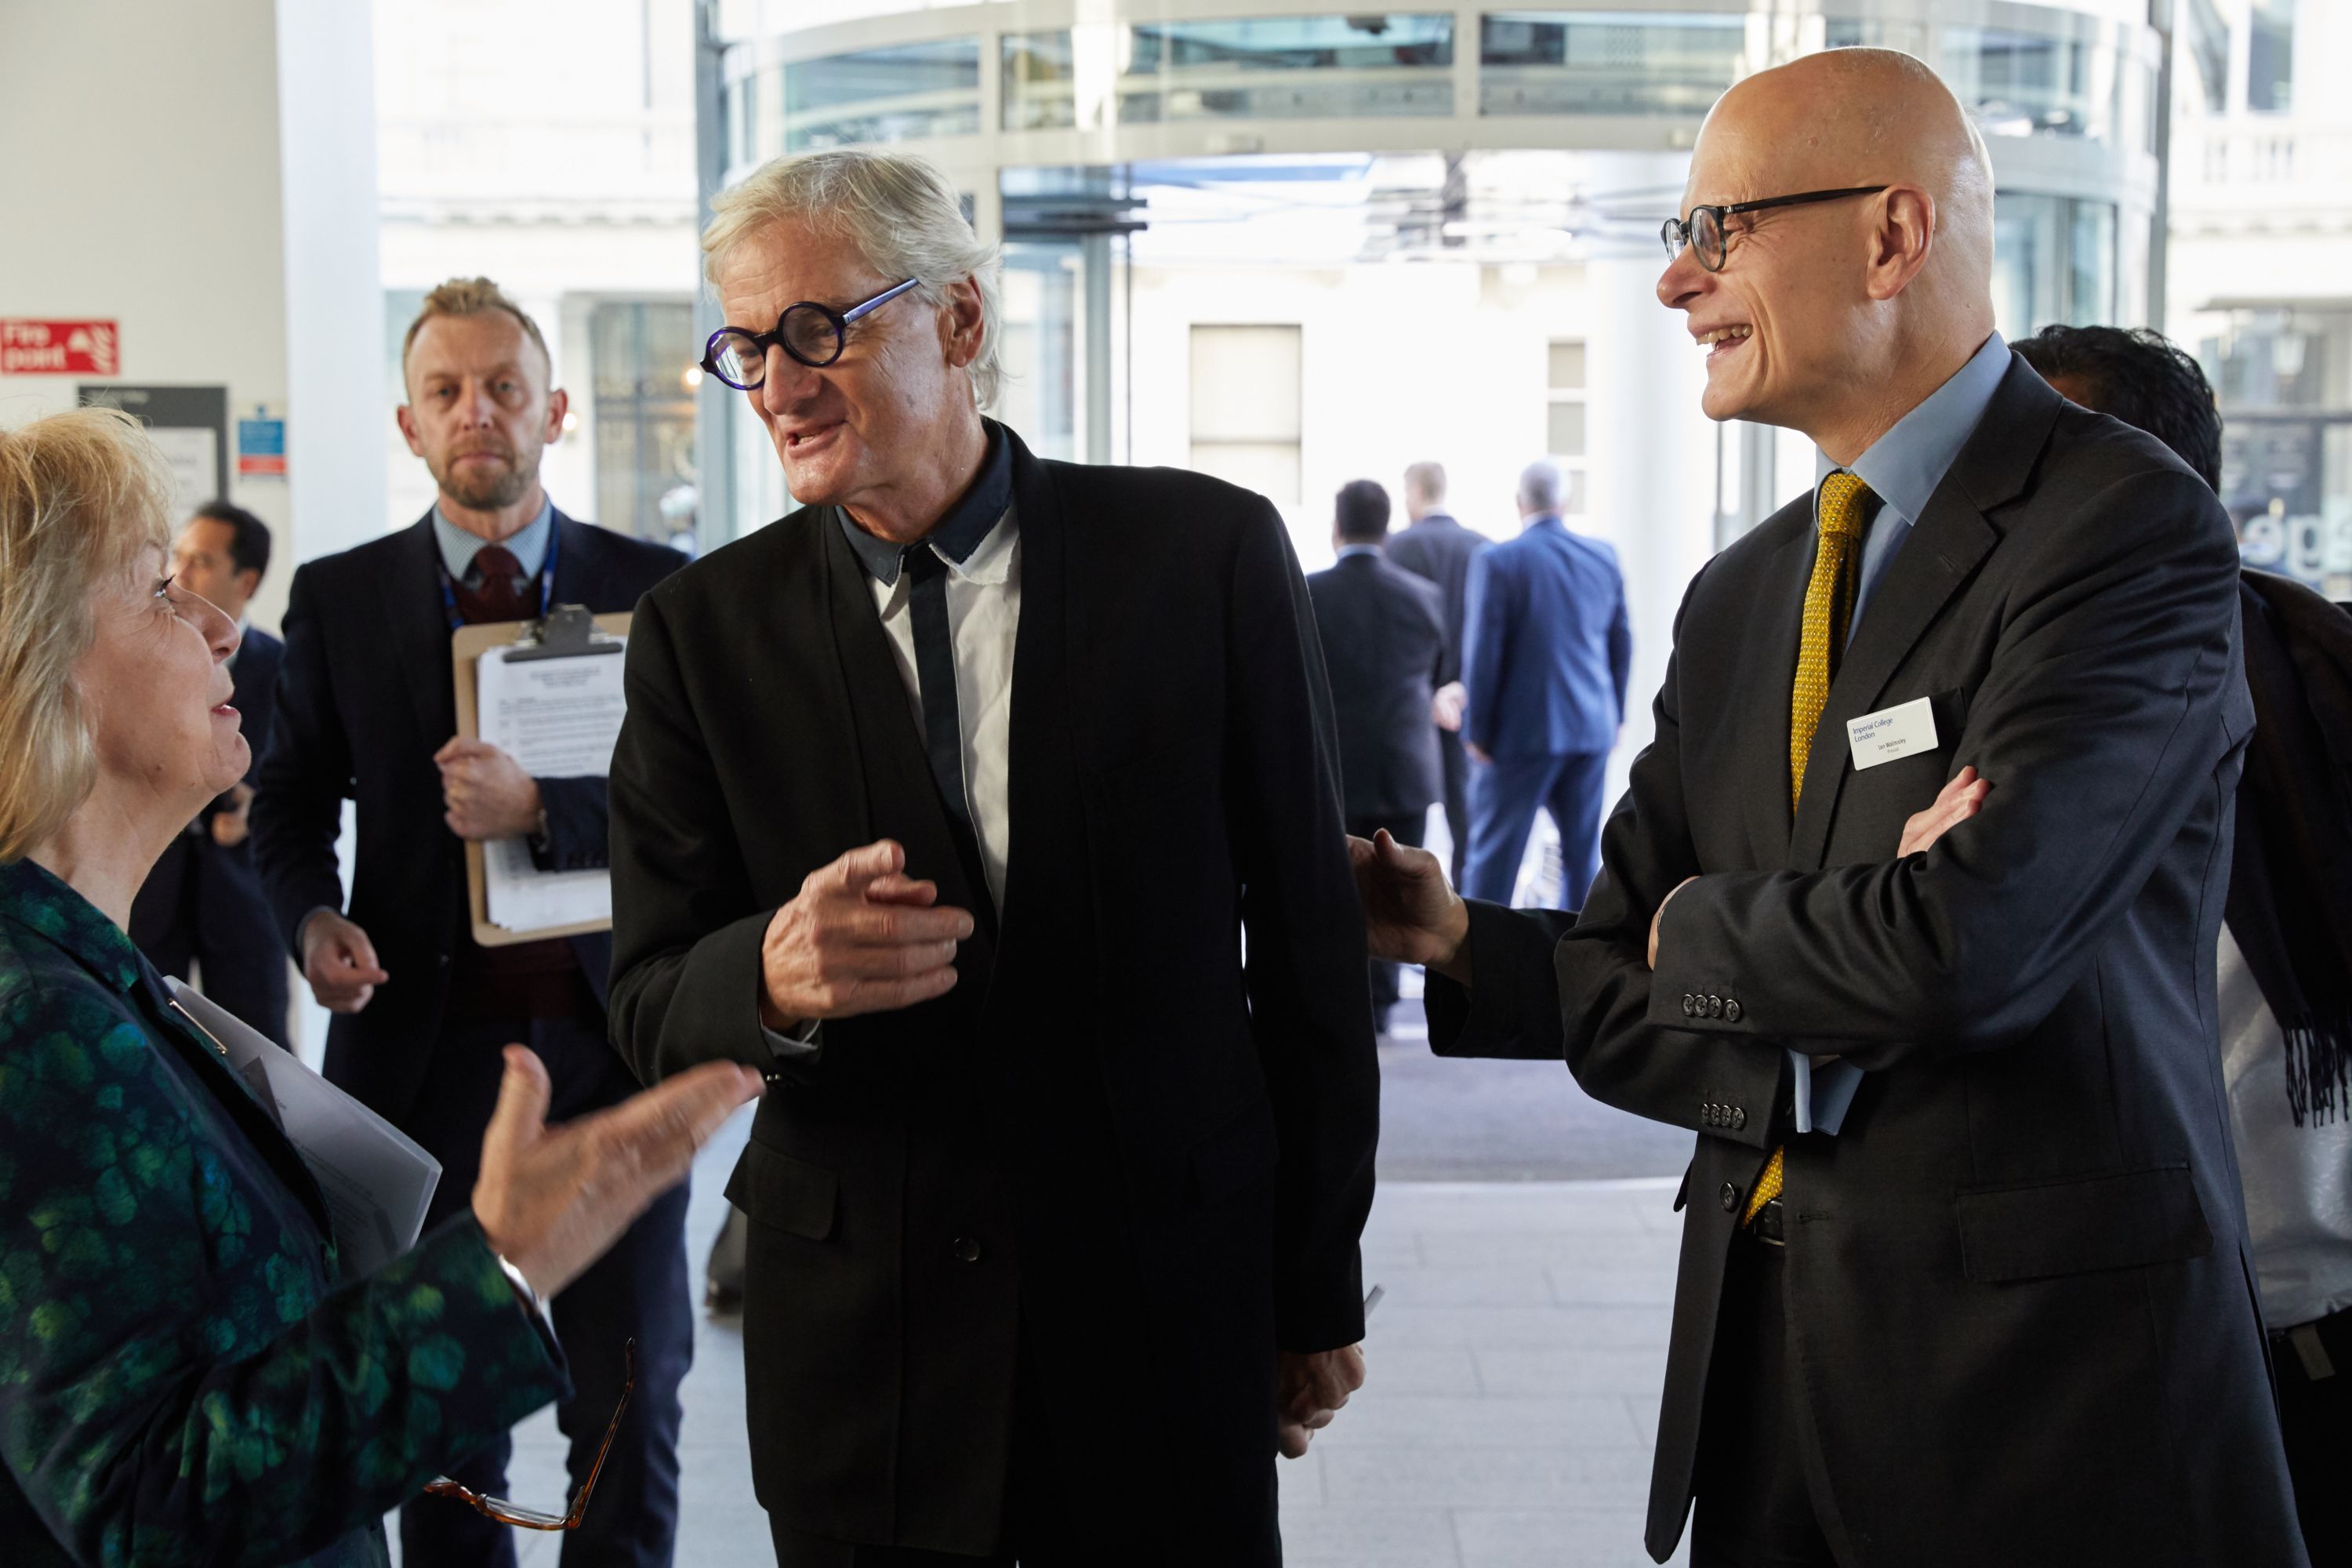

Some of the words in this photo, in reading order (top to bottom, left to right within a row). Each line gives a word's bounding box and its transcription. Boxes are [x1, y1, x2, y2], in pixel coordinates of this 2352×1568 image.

[3, 324, 51, 346] Fire
[4, 343, 67, 372] point
[1853, 722, 1873, 734] Imperial
[1875, 717, 1893, 728] College
[1854, 732, 1875, 742] London
